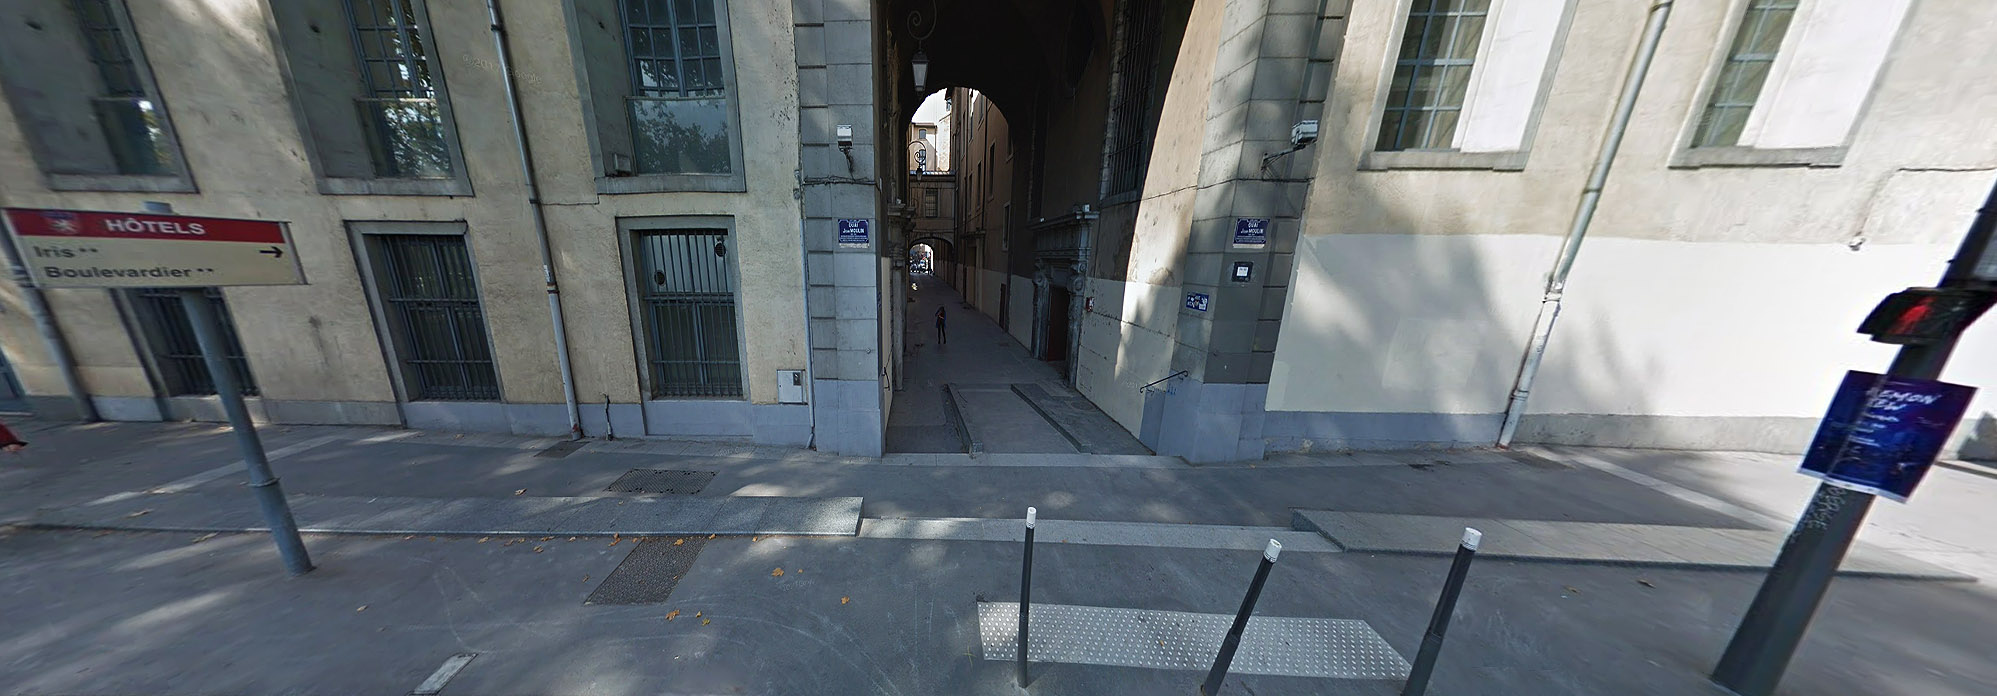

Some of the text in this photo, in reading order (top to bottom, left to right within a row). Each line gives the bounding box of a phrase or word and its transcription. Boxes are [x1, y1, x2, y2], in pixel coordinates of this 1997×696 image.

[105, 216, 207, 236] HÔTELS
[33, 245, 75, 259] Iris
[44, 266, 192, 279] Boulevardier
